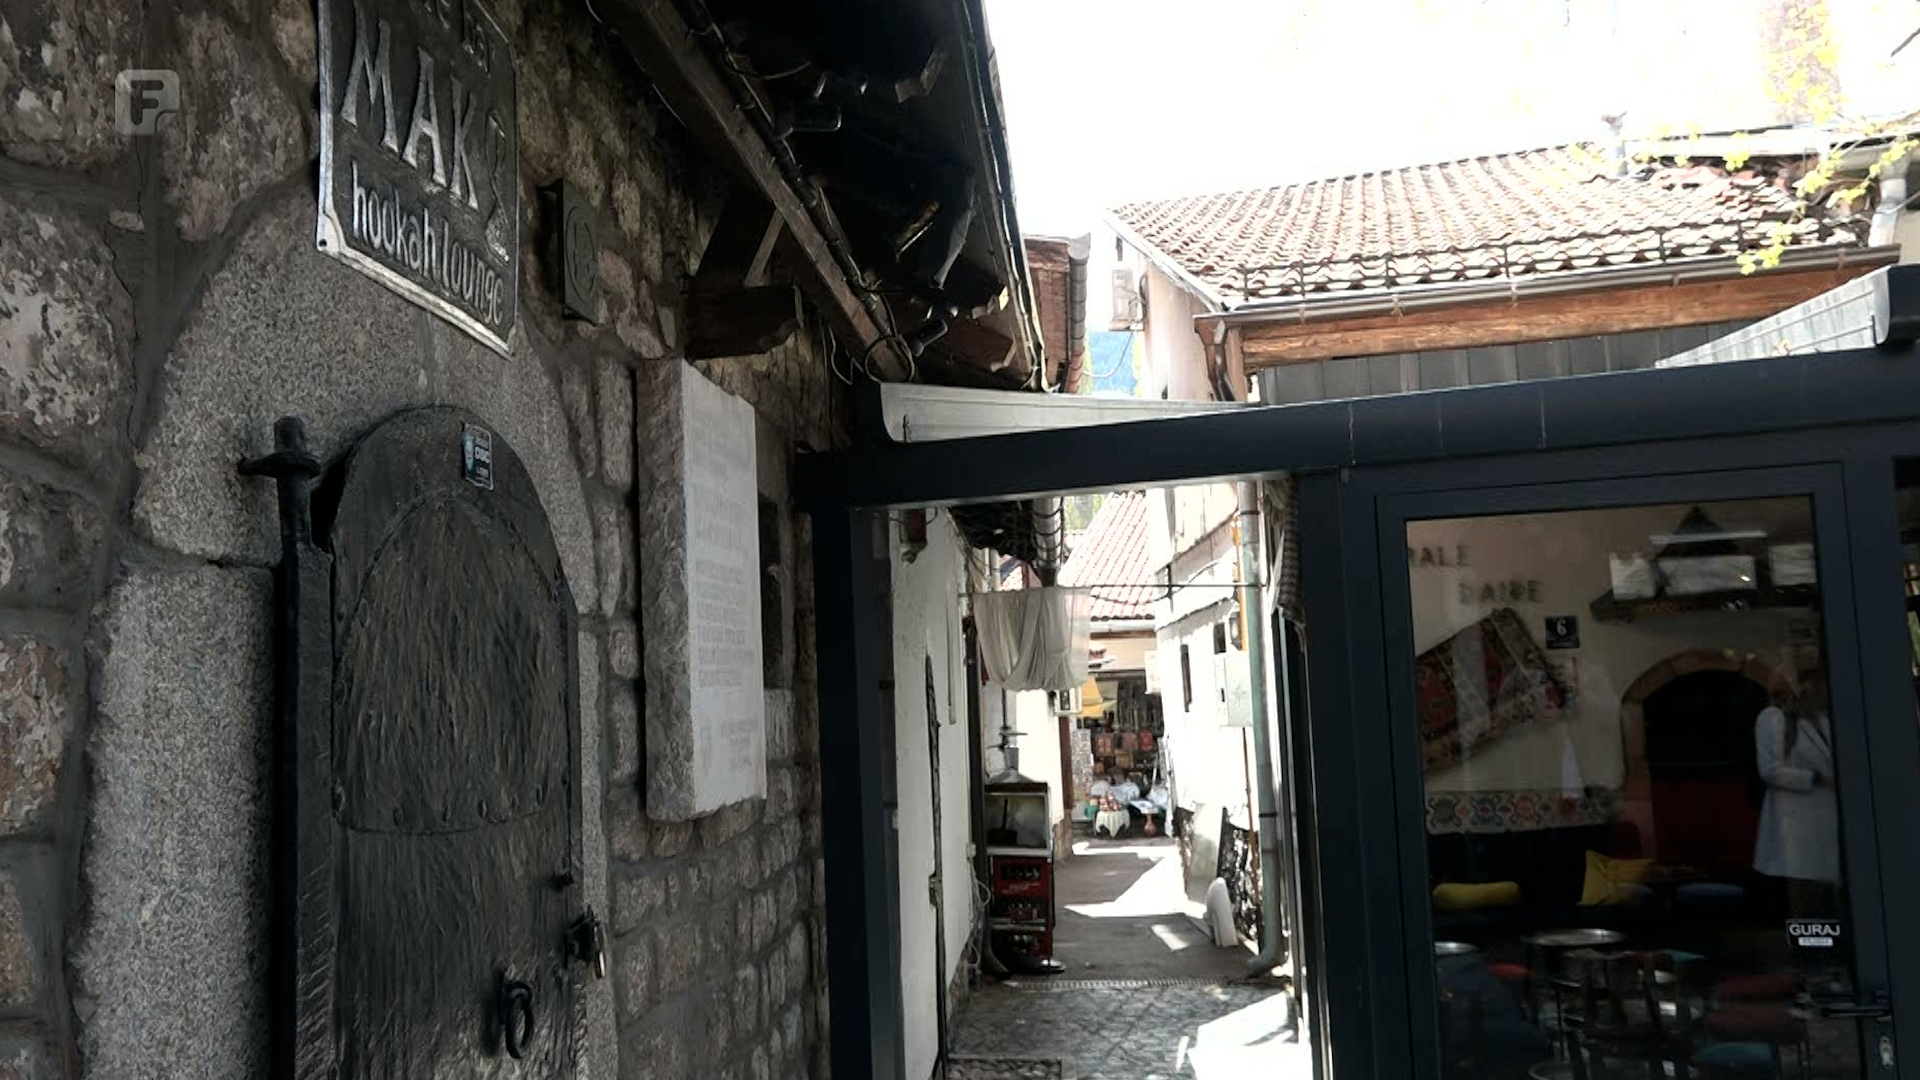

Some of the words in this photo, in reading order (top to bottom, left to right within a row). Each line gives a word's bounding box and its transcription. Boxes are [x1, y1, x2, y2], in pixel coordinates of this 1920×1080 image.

[340, 0, 479, 212] MAK
[352, 159, 438, 284] hookah
[1556, 618, 1567, 636] 6
[1789, 924, 1840, 936] GURAJ
